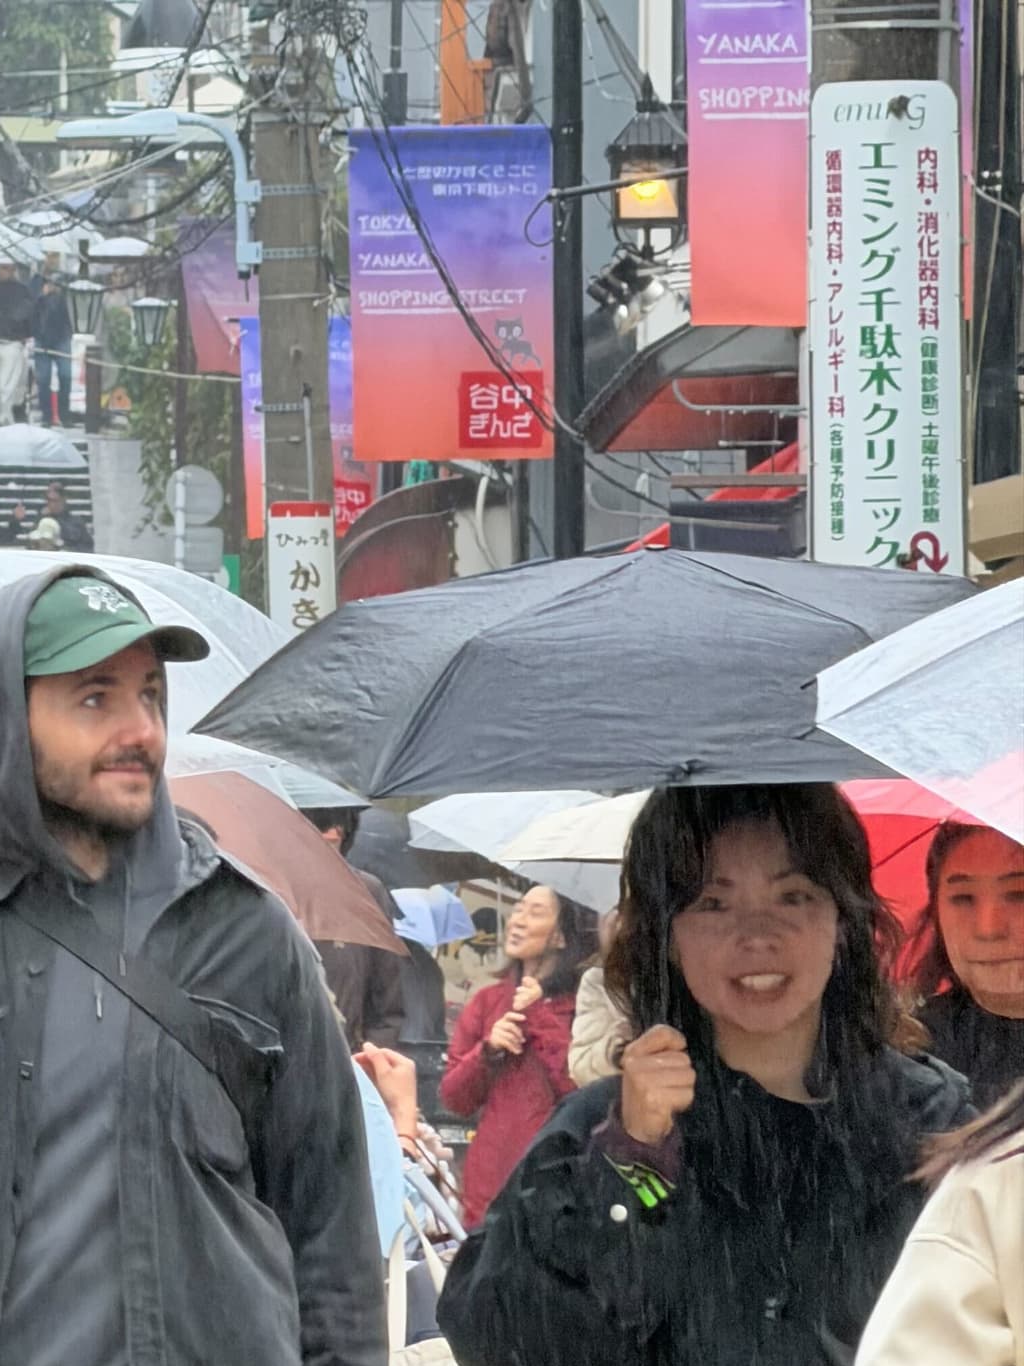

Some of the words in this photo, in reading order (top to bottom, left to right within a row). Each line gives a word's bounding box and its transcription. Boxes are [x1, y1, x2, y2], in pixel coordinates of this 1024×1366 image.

[697, 32, 799, 55] YANAKA
[357, 252, 431, 268] YANAKA
[357, 289, 450, 307] SHOPPING
[857, 142, 902, 568] エミング千駄木クリニック
[469, 383, 533, 410] 谷中
[468, 411, 534, 438] ぎんざ
